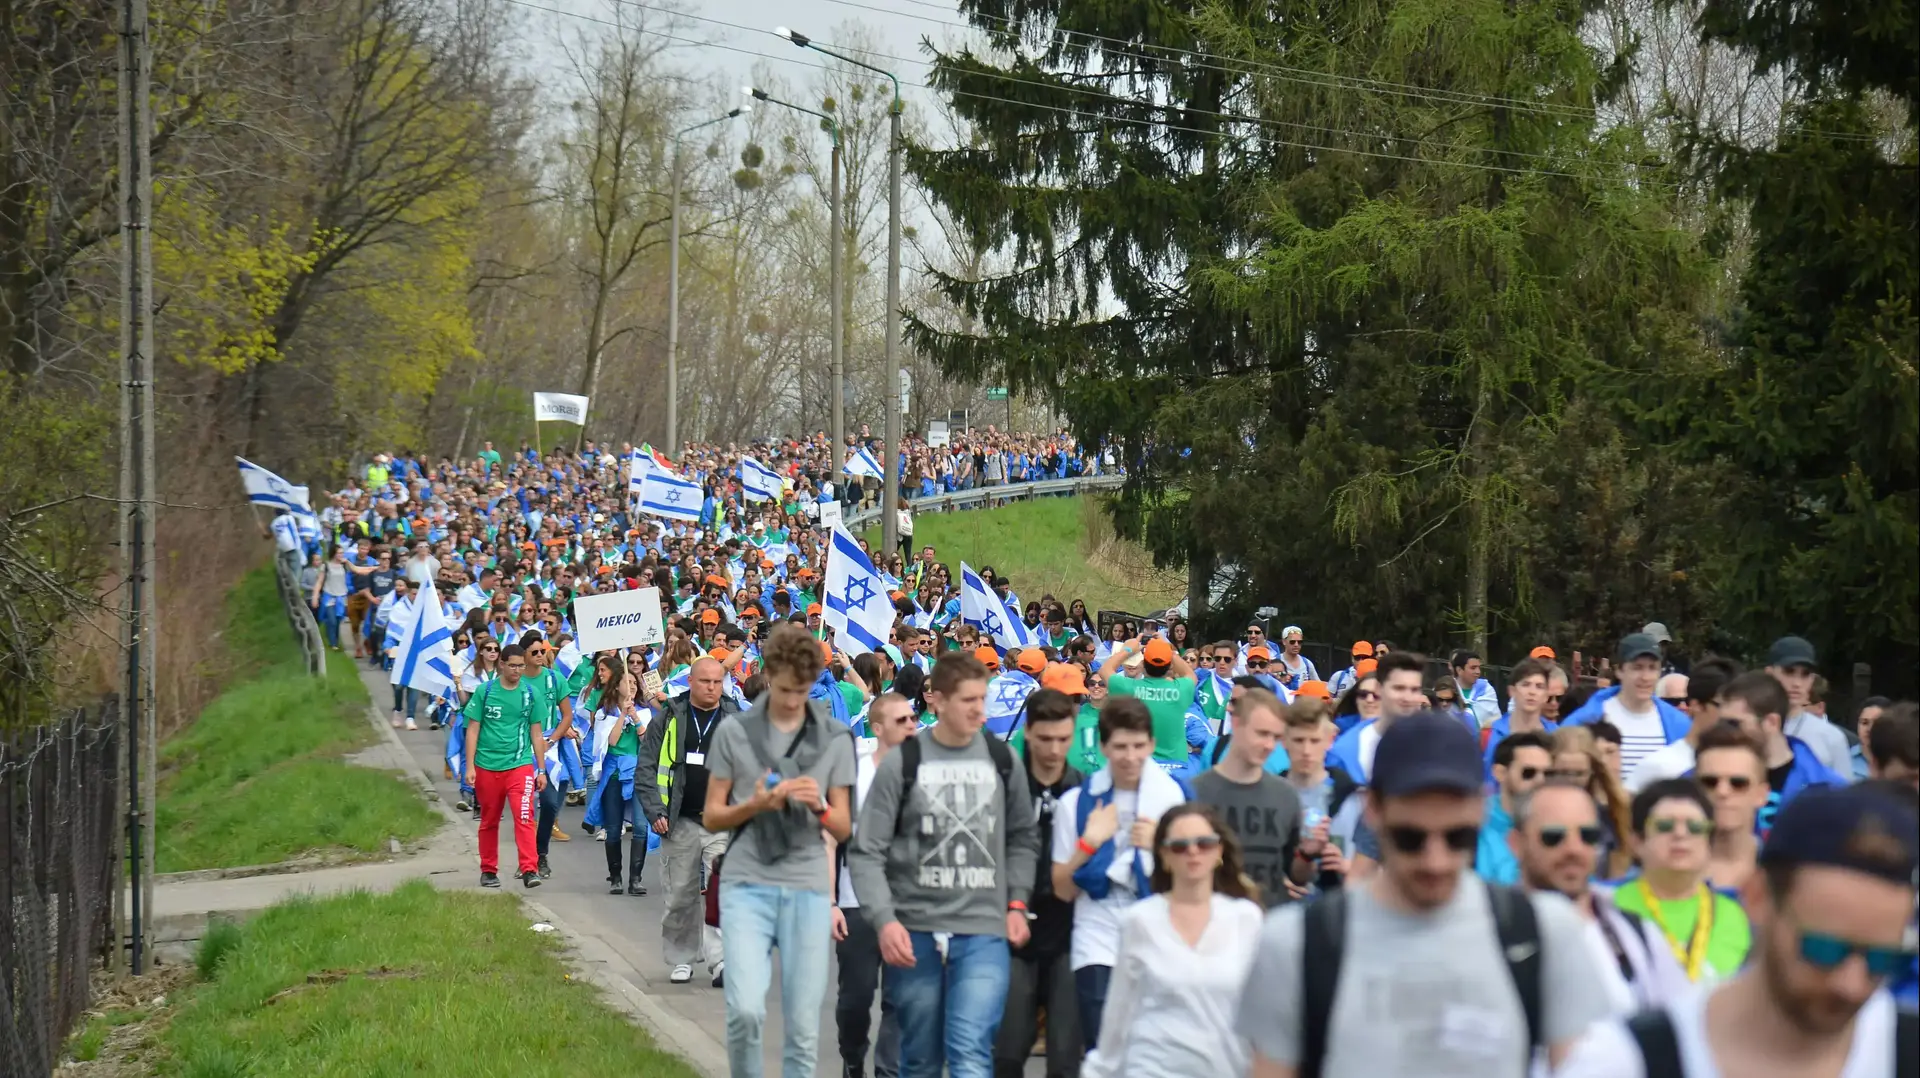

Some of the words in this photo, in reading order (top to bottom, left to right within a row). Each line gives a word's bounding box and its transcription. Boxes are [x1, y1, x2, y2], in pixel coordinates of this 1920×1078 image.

[596, 612, 641, 628] MEXICO
[1134, 686, 1180, 701] MEXICO
[485, 706, 502, 719] 25
[919, 866, 956, 888] NEW
[957, 867, 997, 889] YORK
